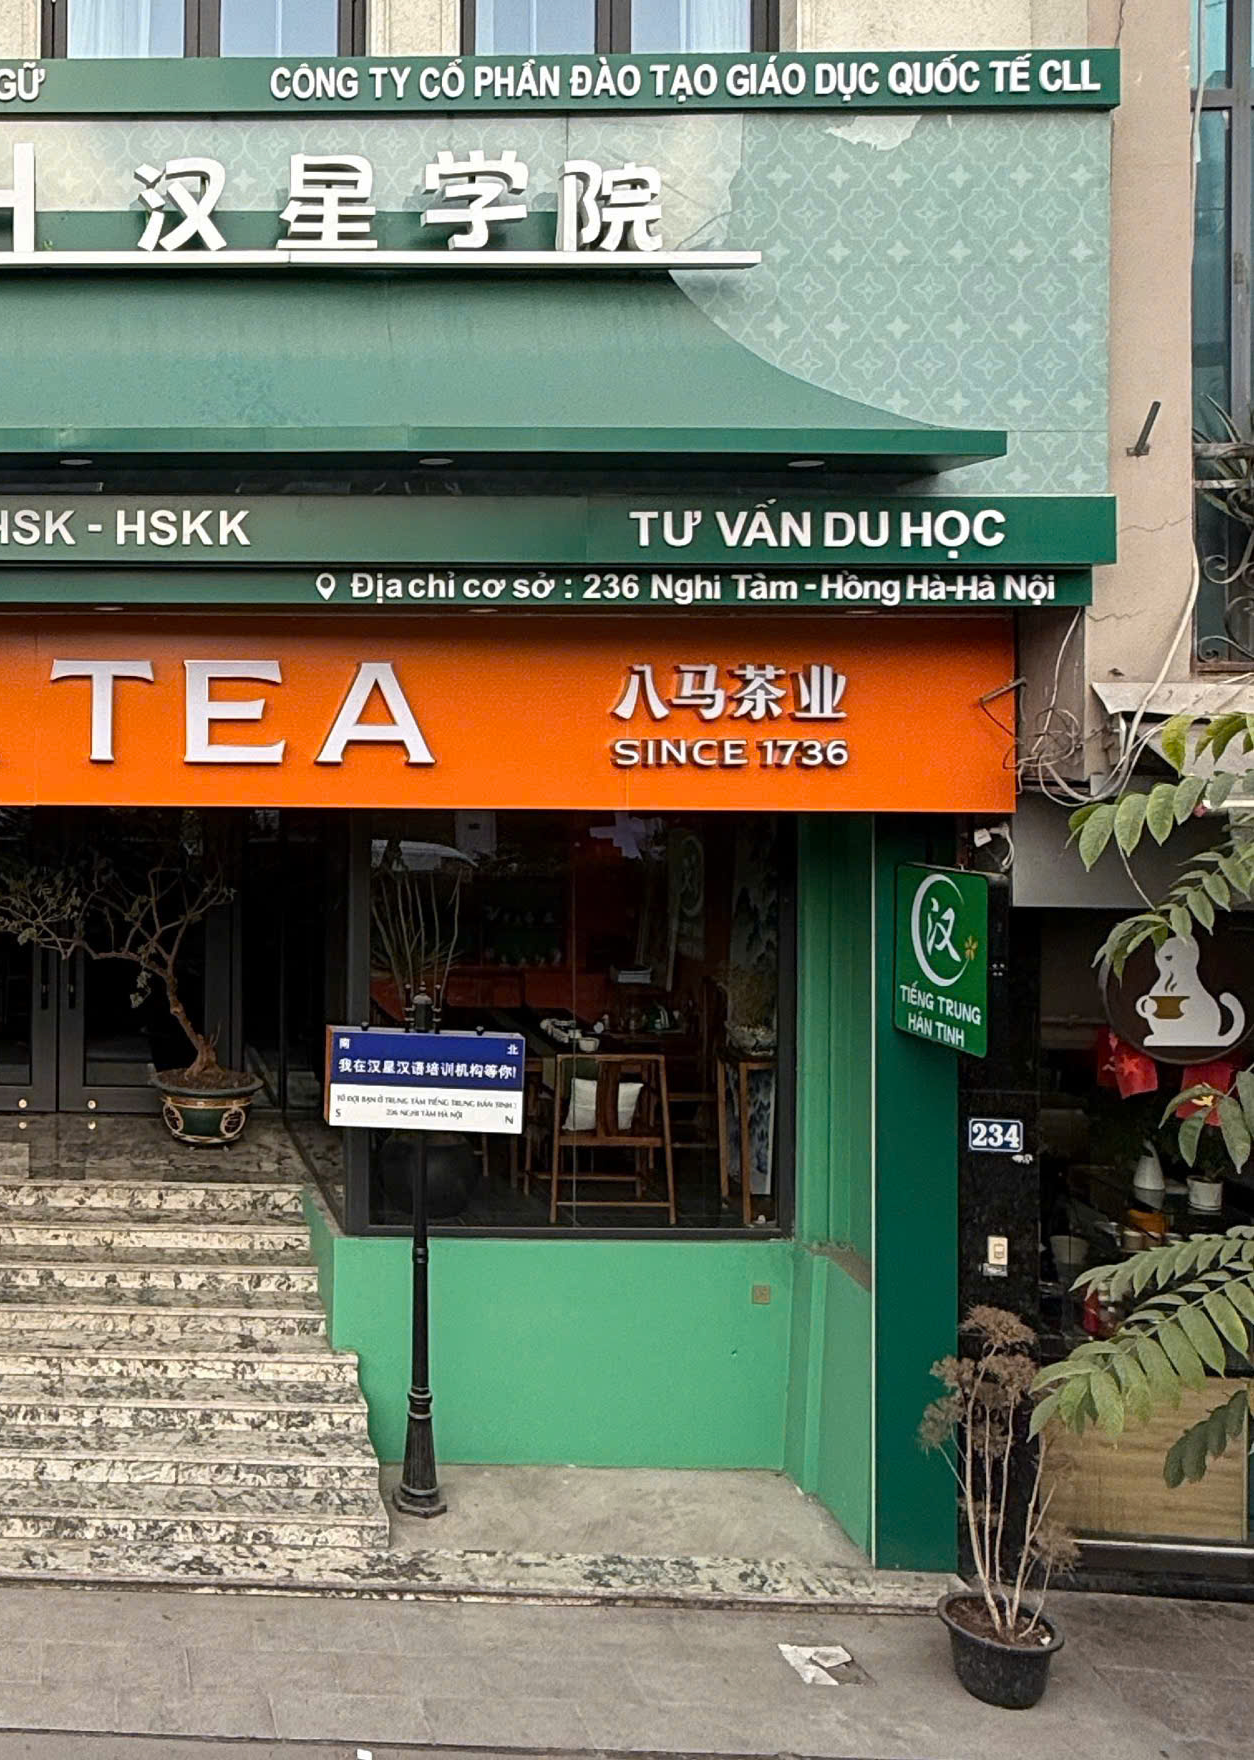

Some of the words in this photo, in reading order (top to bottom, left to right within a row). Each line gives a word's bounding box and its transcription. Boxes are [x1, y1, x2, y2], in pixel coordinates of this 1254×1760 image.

[271, 63, 358, 98] CÔNG
[369, 67, 411, 97] TY
[570, 57, 640, 96] ĐÀO
[650, 64, 717, 101] TẠO
[727, 56, 805, 95] GIÁO
[816, 63, 879, 100] DỤC
[889, 54, 979, 95] QUỐC
[990, 54, 1031, 91] TẾ
[1040, 60, 1100, 91] CLL
[132, 149, 664, 252] 汉星学院
[117, 510, 250, 545] HSKK
[630, 511, 701, 546] TƯ
[716, 500, 810, 546] VẤN
[825, 512, 888, 546] DU
[902, 510, 1005, 558] HỌC
[351, 574, 402, 603] Địa
[408, 572, 454, 597] chỉ
[464, 580, 505, 597] cơ
[513, 573, 555, 598] sở
[584, 576, 638, 598] 236
[651, 575, 720, 604] Nghi
[1004, 575, 1054, 605] Nội
[612, 664, 848, 721] 八马茶业
[49, 658, 436, 765] TEA
[614, 739, 750, 766] SINCE
[761, 739, 848, 766] 1736
[899, 980, 935, 1011] TIẾNG
[936, 995, 982, 1026] TRUNG
[907, 1010, 933, 1036] HÁN
[934, 1021, 965, 1048] TINH
[507, 1044, 519, 1055] 北
[335, 1107, 341, 1119] S
[505, 1114, 514, 1126] N
[972, 1123, 1020, 1148] 234
